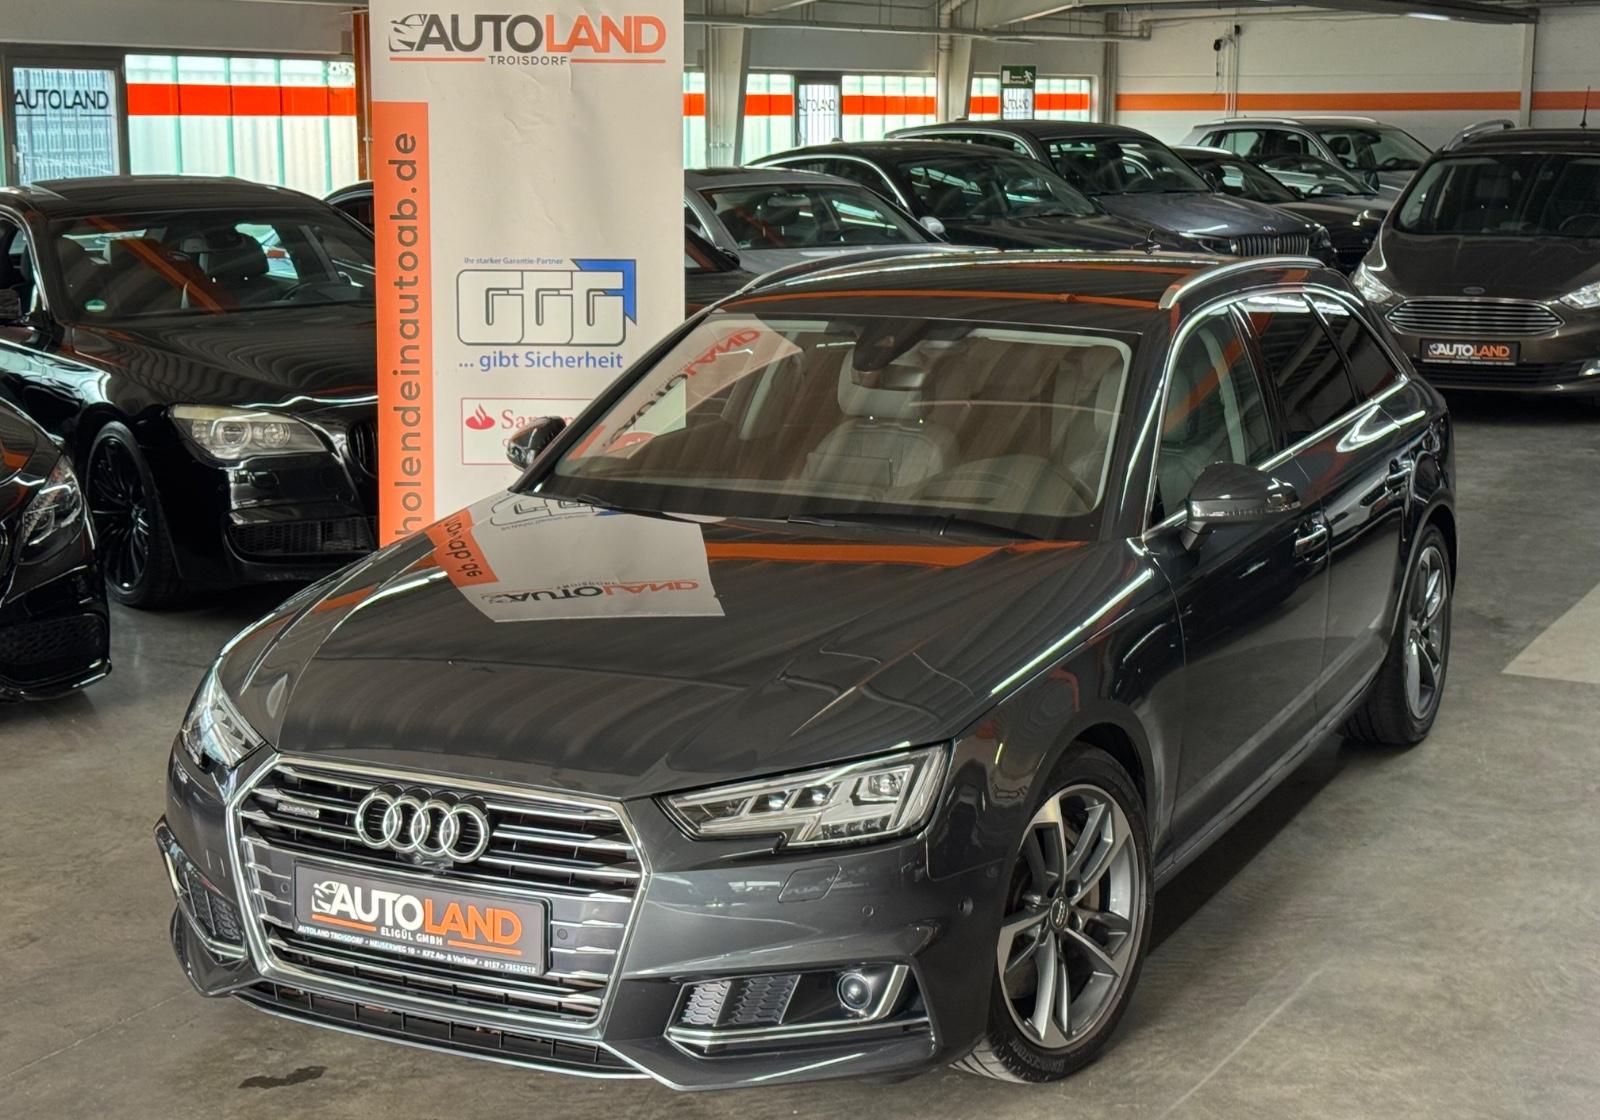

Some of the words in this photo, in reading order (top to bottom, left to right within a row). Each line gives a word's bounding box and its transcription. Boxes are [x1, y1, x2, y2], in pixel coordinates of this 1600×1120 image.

[414, 14, 667, 53] AUTOLAND
[488, 55, 568, 65] TROISDORF
[15, 89, 109, 109] AUTOLAND
[388, 132, 422, 535] holendeinautoab.de
[1438, 343, 1510, 357] AUTOLAND
[479, 351, 519, 371] gibt
[525, 351, 623, 368] Sicherheit
[330, 883, 522, 945] AUTOLAND
[298, 925, 330, 937] AUTOLAND
[330, 931, 364, 944] TROISDORF
[453, 955, 478, 965] Verkauf
[381, 926, 413, 941] ELIGÜL
[416, 933, 443, 945] GMBH
